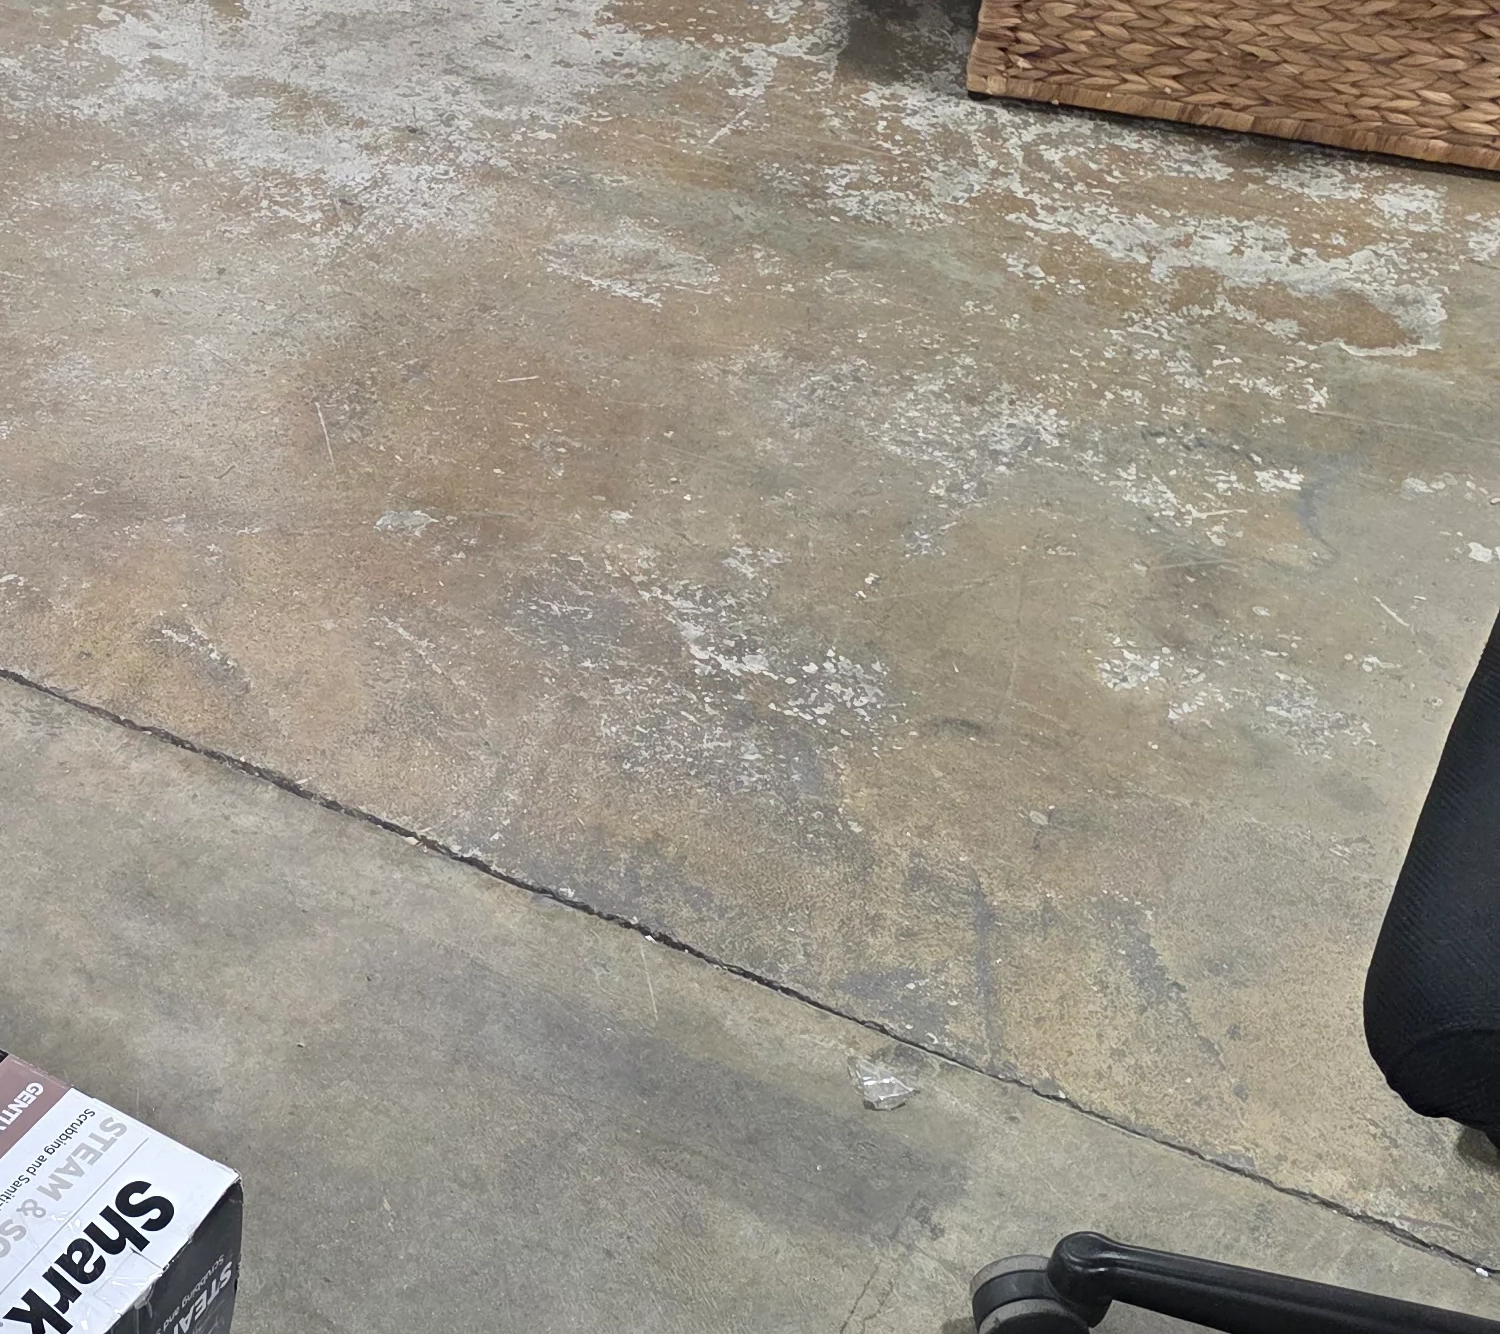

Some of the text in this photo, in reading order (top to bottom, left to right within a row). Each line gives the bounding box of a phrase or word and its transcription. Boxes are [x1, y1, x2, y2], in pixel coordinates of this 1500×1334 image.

[43, 1108, 96, 1156] Scrubbing
[28, 1154, 48, 1177] and
[37, 1117, 128, 1202] STEAM
[16, 1199, 47, 1219] &
[181, 1254, 224, 1309] Scrubbing
[162, 1306, 180, 1330] and
